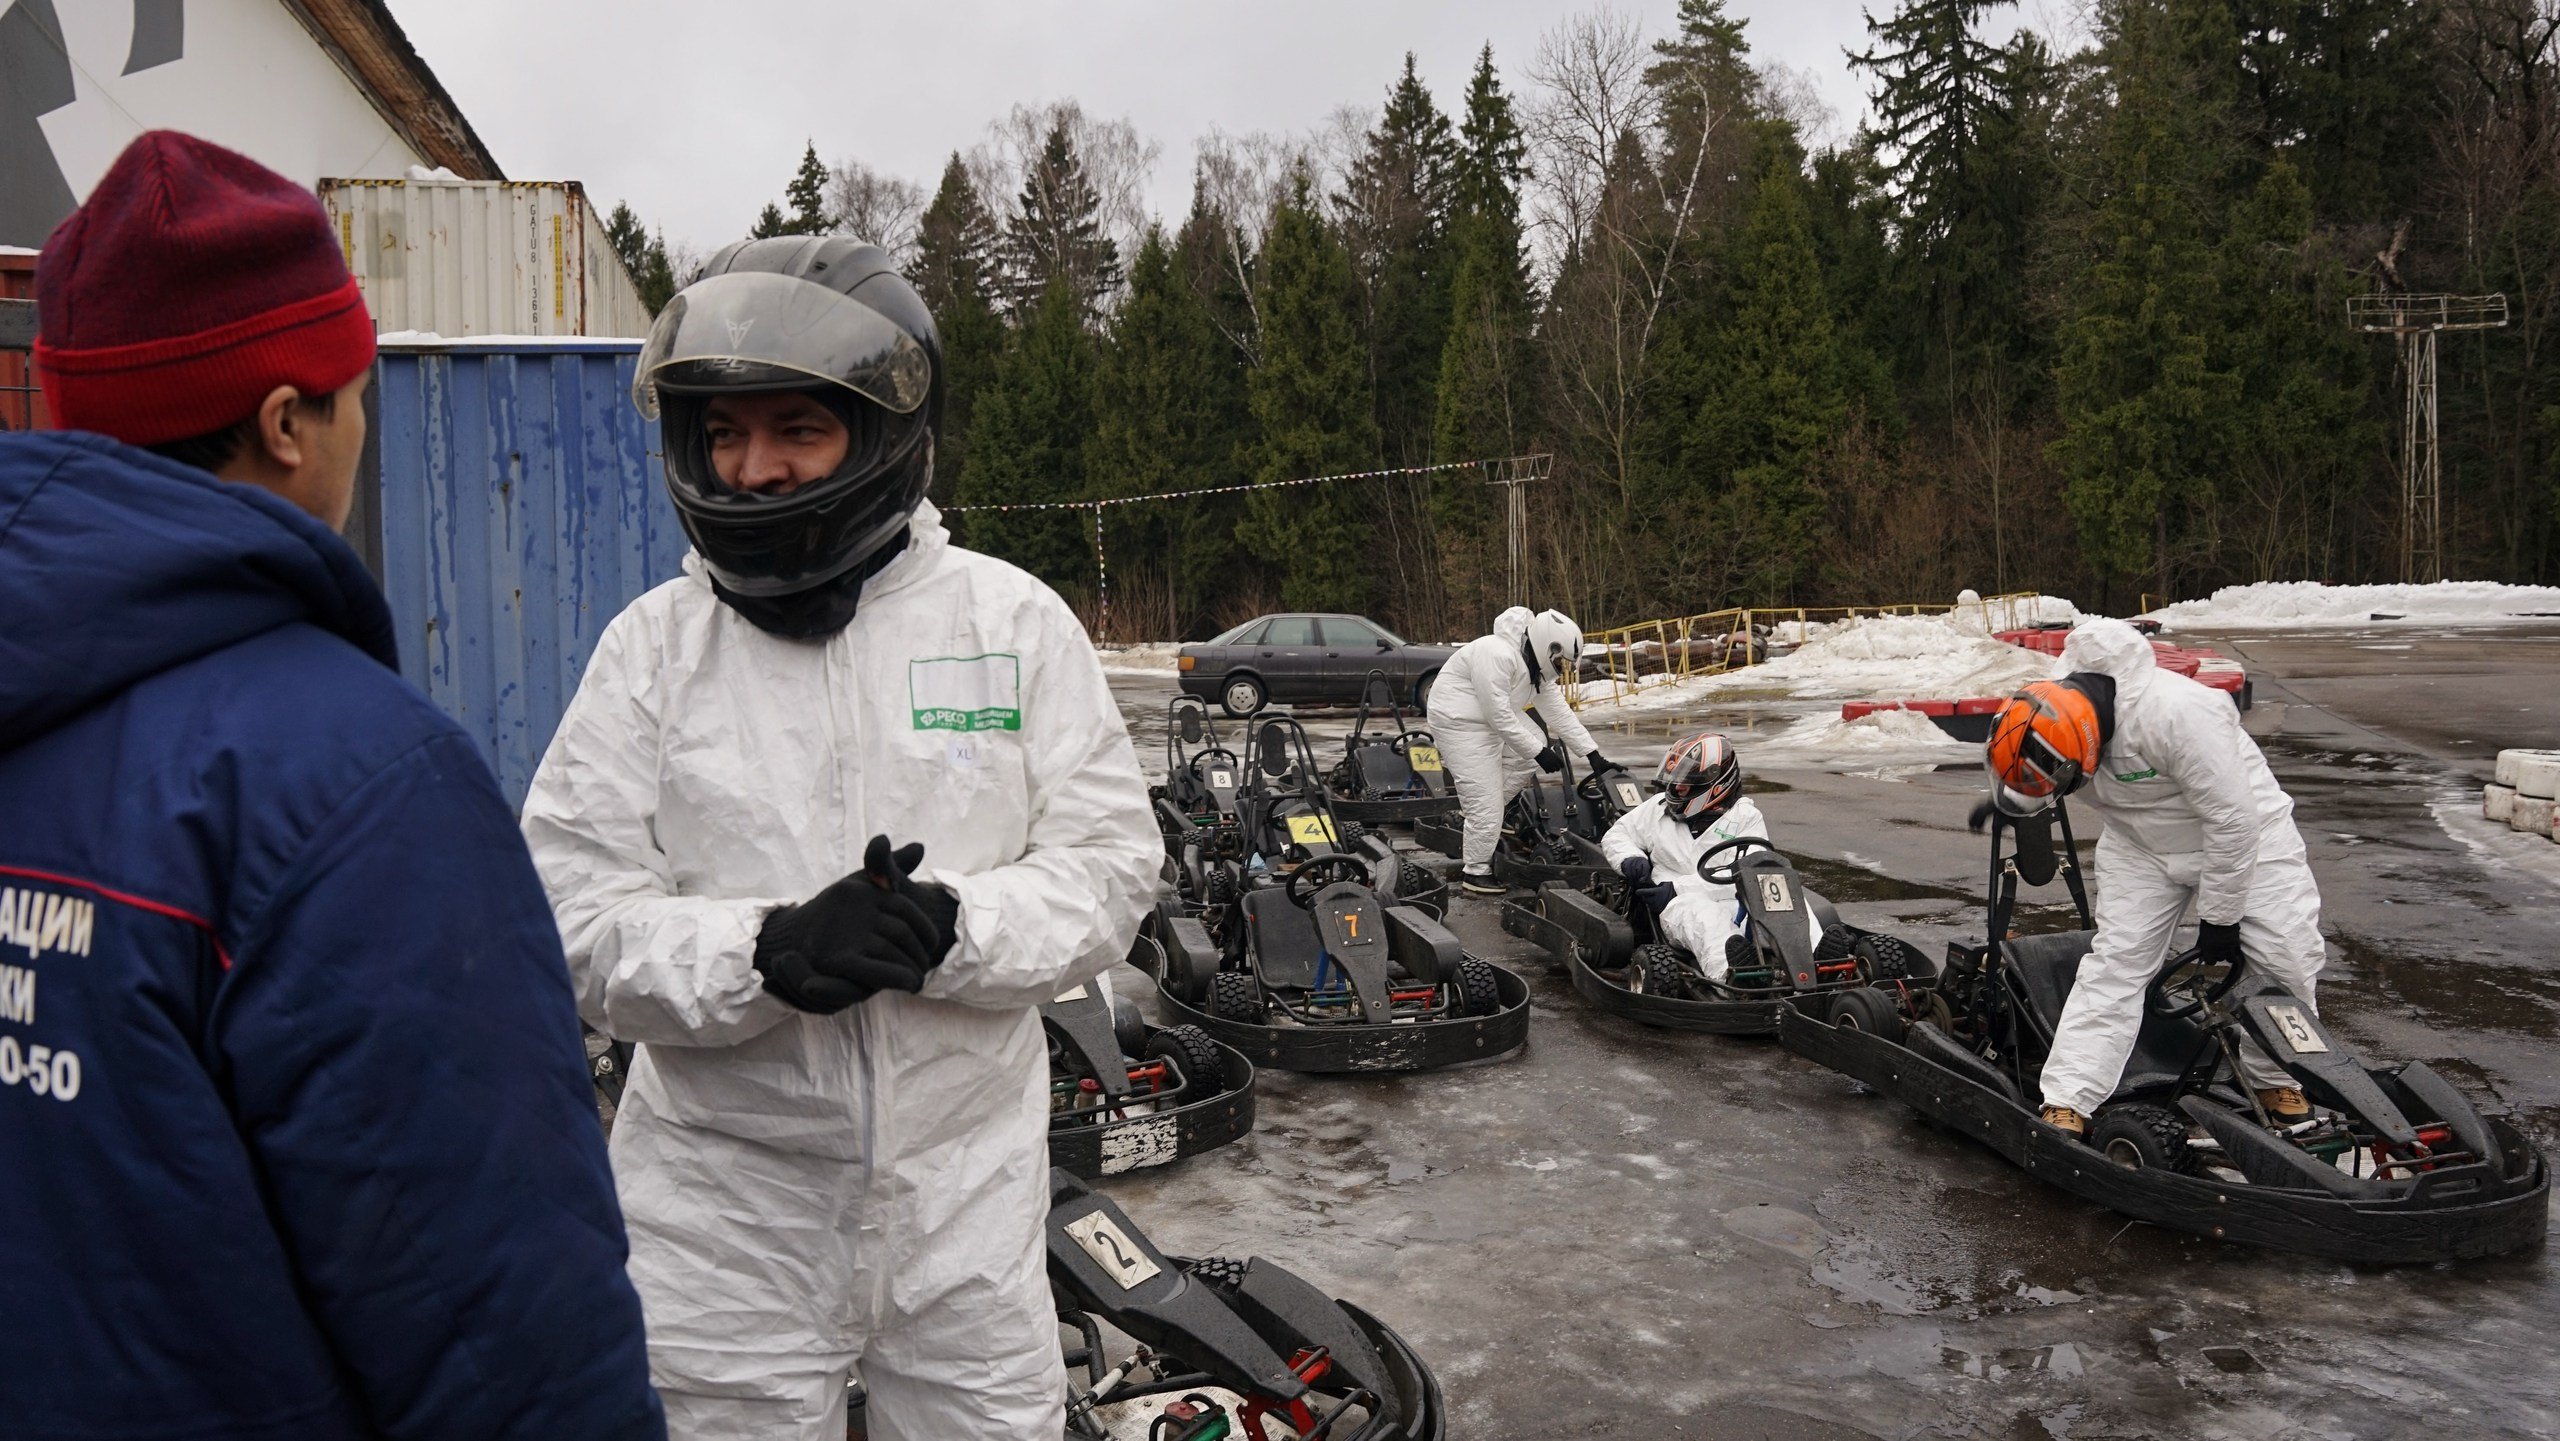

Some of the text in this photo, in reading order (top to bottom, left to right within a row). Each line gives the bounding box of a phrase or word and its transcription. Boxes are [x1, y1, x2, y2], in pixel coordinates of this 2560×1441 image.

[955, 746, 972, 760] XL
[1218, 774, 1226, 785] 8
[1626, 788, 1636, 801] 1
[1304, 823, 1321, 836] 4
[1769, 882, 1782, 903] 9
[0, 886, 95, 959] АЦИИ
[1344, 914, 1358, 937] 7
[2285, 1015, 2309, 1042] 5
[1093, 1230, 1136, 1270] 2
